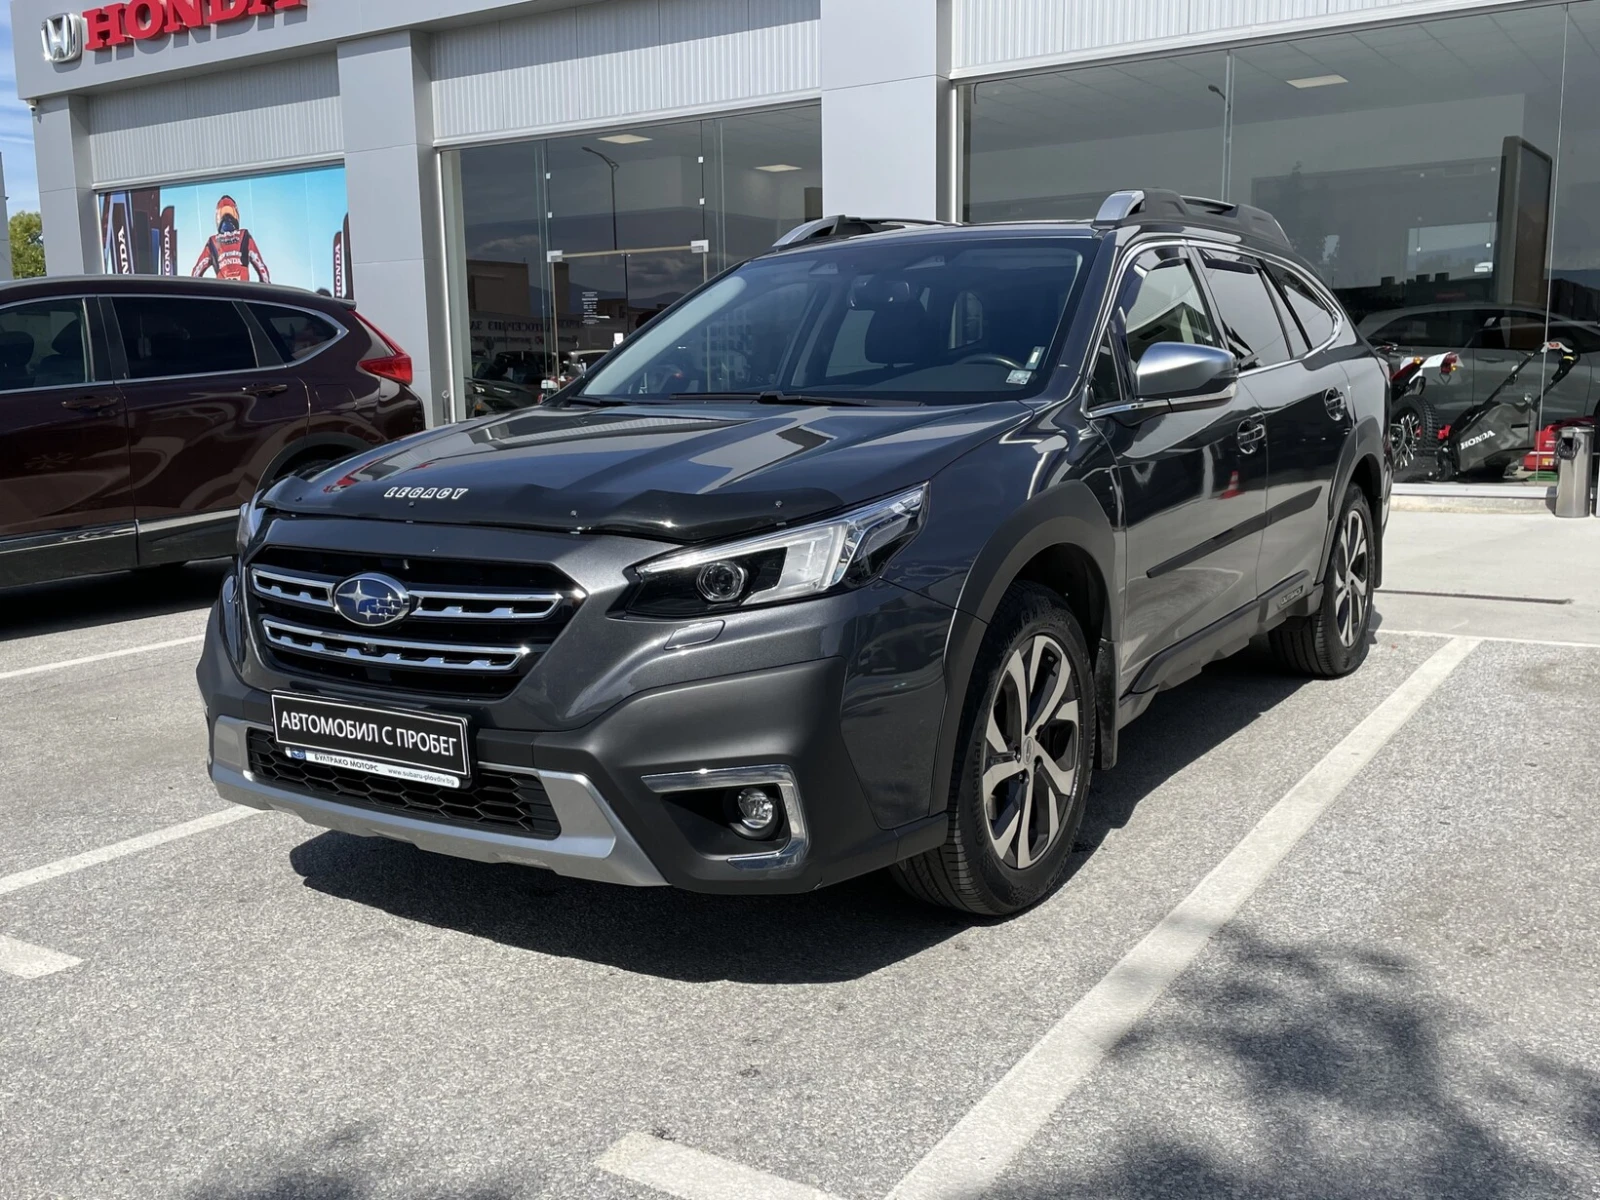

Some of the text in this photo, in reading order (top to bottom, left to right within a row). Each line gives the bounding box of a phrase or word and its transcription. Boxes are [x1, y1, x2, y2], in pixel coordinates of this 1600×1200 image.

[83, 0, 308, 50] HOND
[118, 226, 129, 275] NDA
[1460, 429, 1496, 451] HONDA
[383, 486, 469, 500] LEGACY
[280, 710, 457, 757] АВТОМОБИЛ С ПРОБЕГ
[314, 753, 379, 772] БУЛТРАКО МОТОРС
[387, 767, 455, 786] www.subaru-plovdiv.bg
